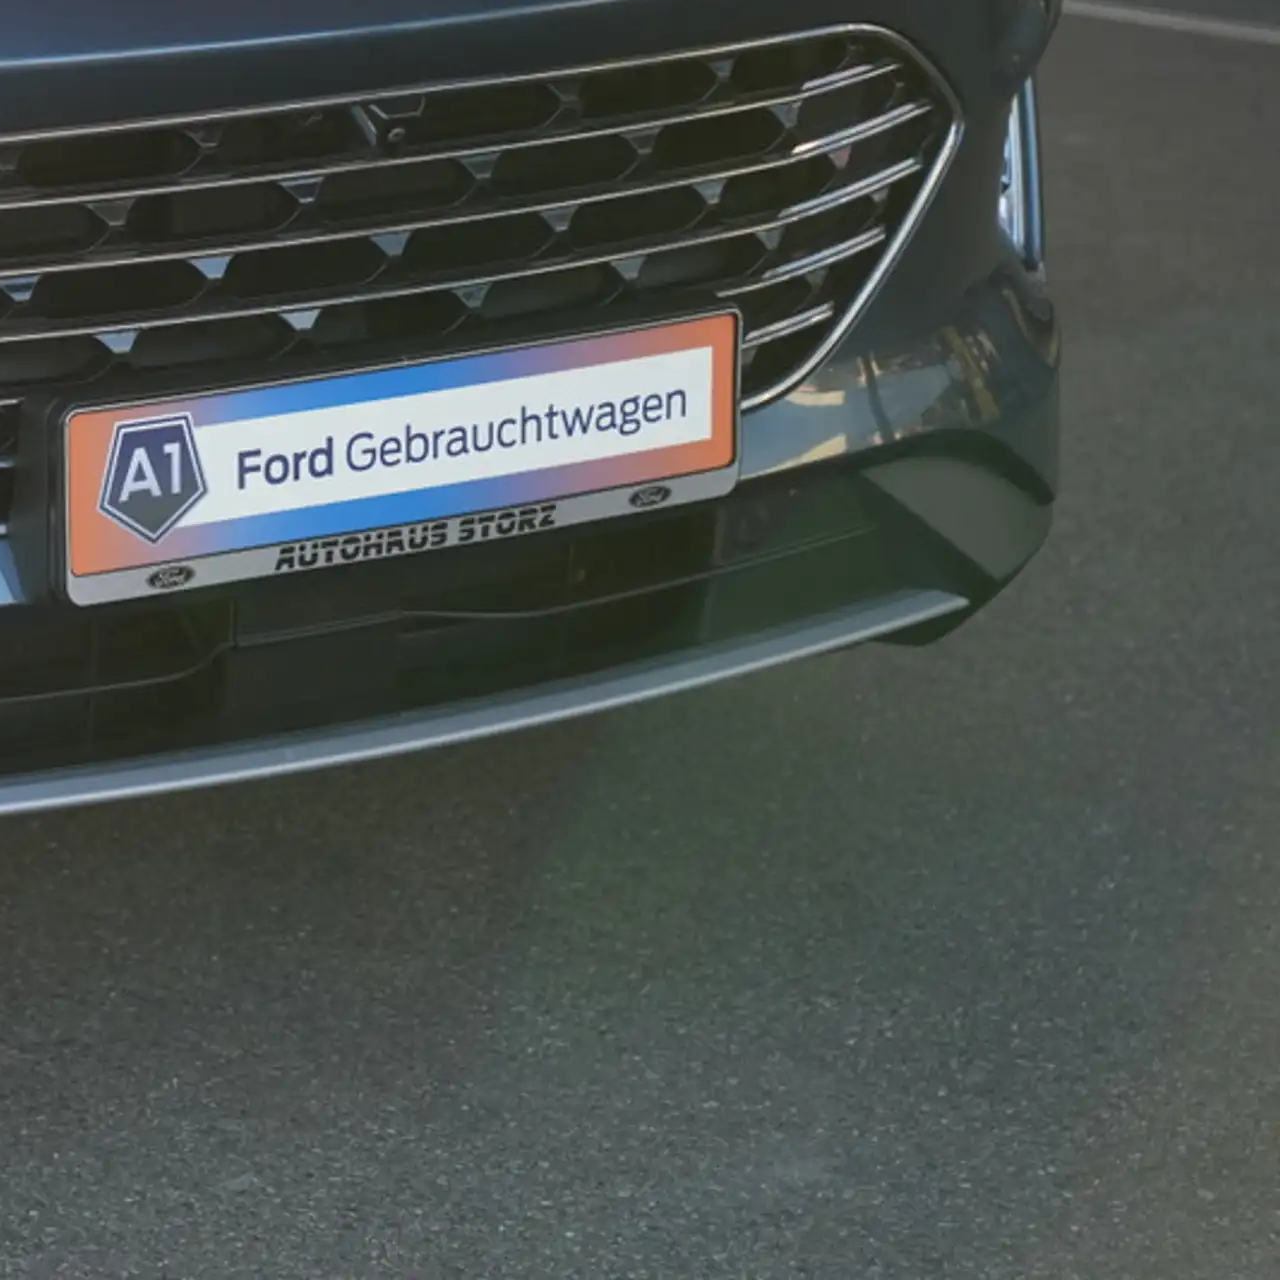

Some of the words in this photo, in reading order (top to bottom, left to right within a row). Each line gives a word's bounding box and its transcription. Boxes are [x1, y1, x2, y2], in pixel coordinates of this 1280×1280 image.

[118, 441, 183, 504] A1
[237, 436, 335, 491] Ford
[346, 389, 687, 472] Gebrauchtwagen
[274, 520, 449, 572] AUTOHAUS
[458, 504, 558, 543] STORZ
